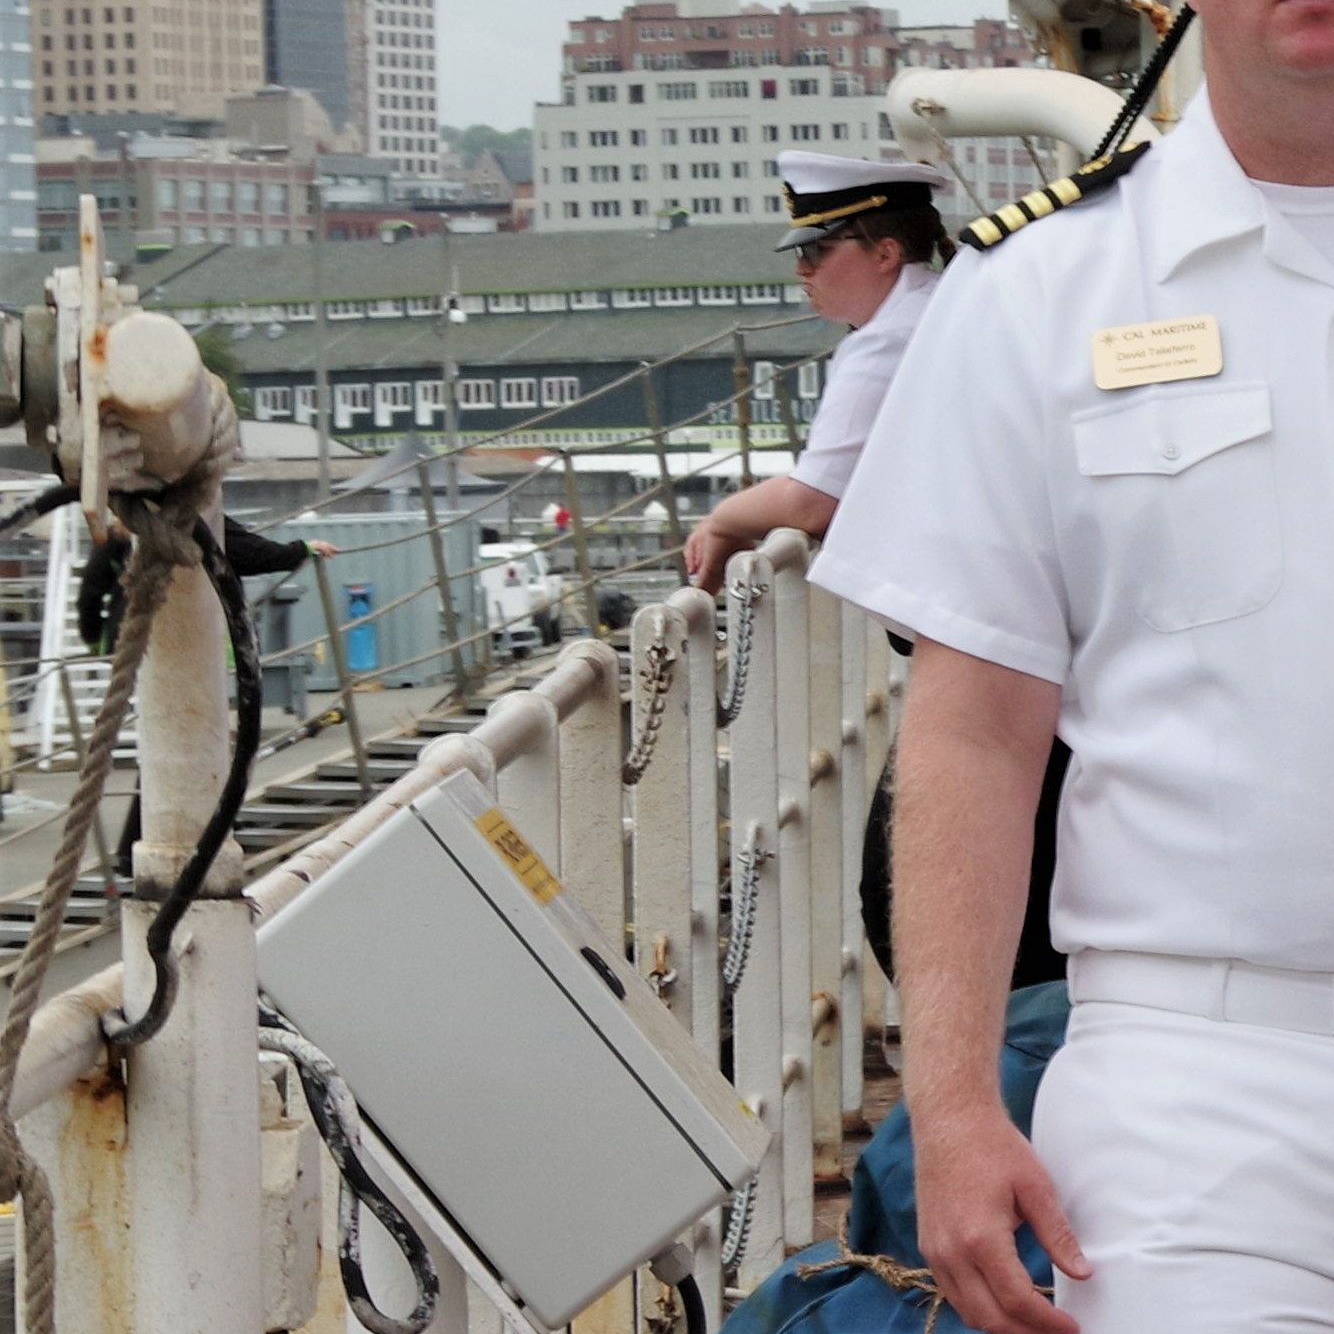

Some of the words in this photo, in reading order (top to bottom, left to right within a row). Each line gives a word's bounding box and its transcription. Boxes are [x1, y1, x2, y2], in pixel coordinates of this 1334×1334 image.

[1122, 330, 1145, 341] CAL
[1151, 321, 1208, 338] MARITIME
[1116, 348, 1146, 362] David
